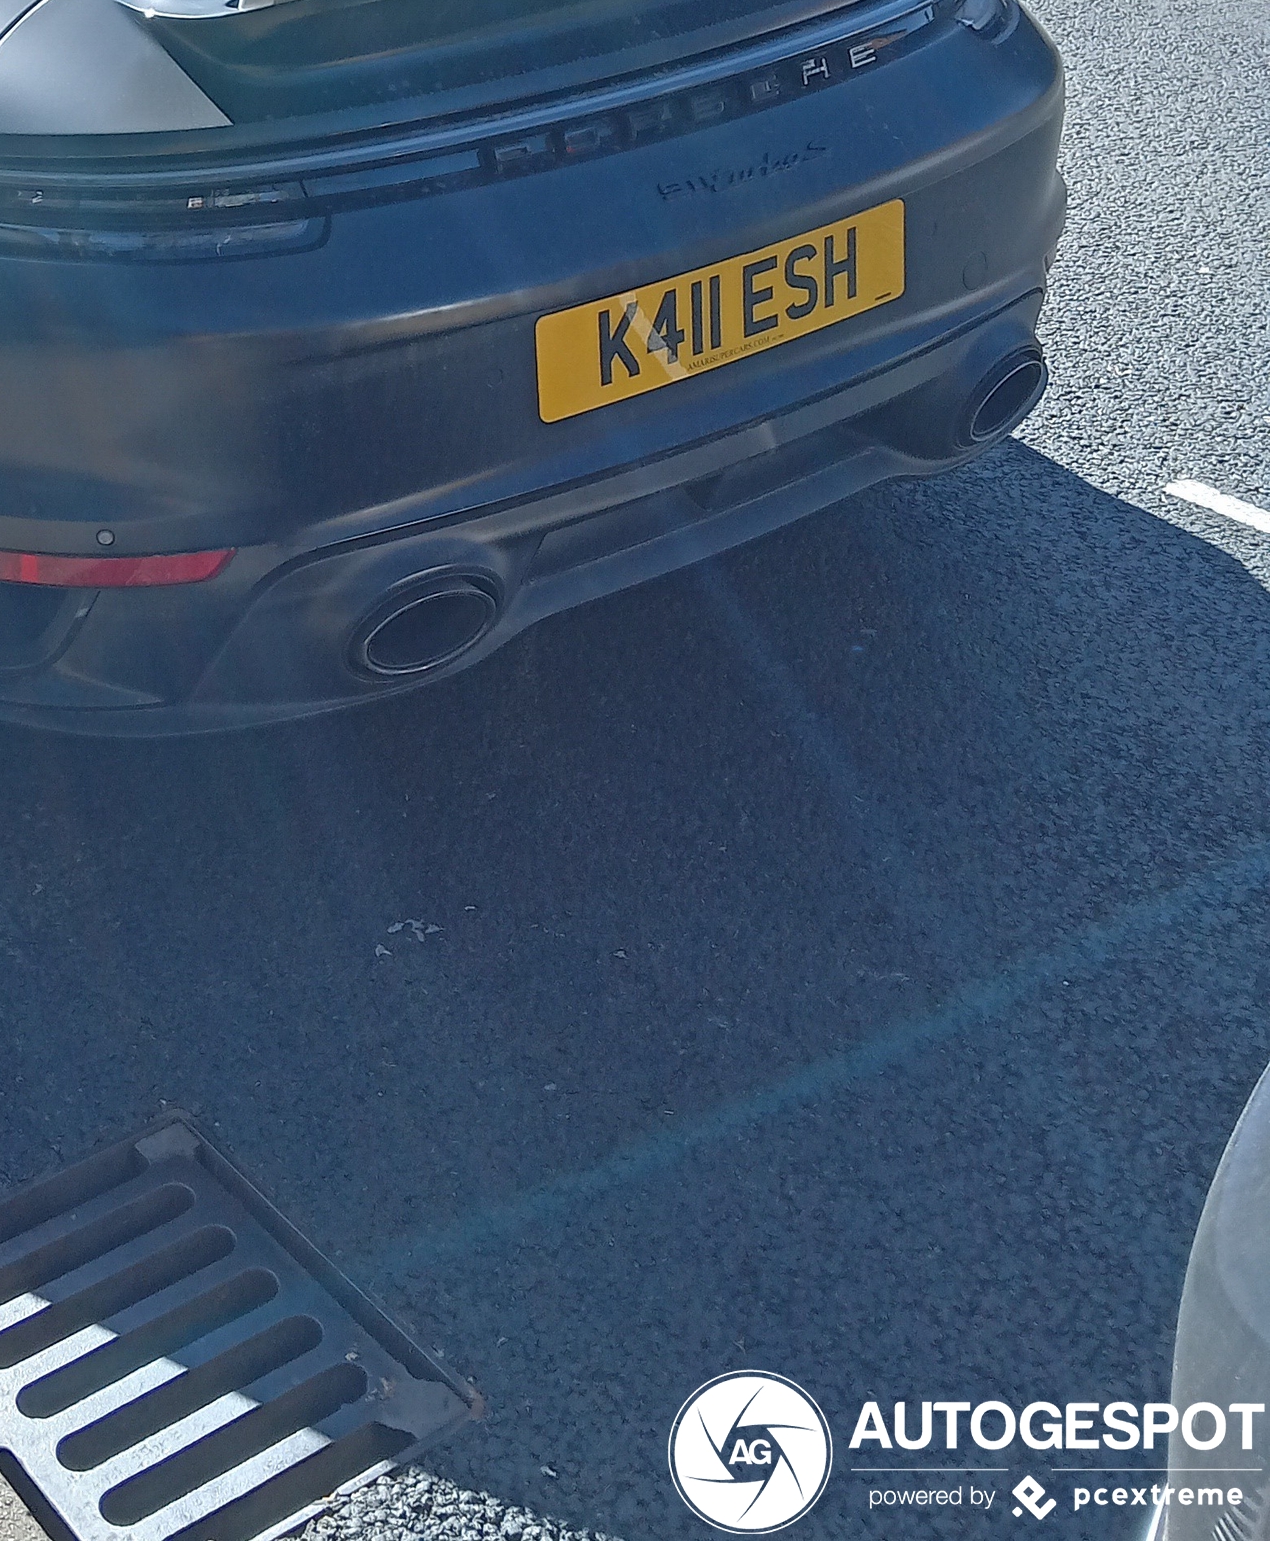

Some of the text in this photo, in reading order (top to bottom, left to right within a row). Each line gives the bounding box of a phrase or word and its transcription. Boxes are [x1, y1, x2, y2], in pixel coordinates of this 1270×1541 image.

[493, 46, 877, 174] PORSCHE
[598, 226, 857, 387] K411 ESH
